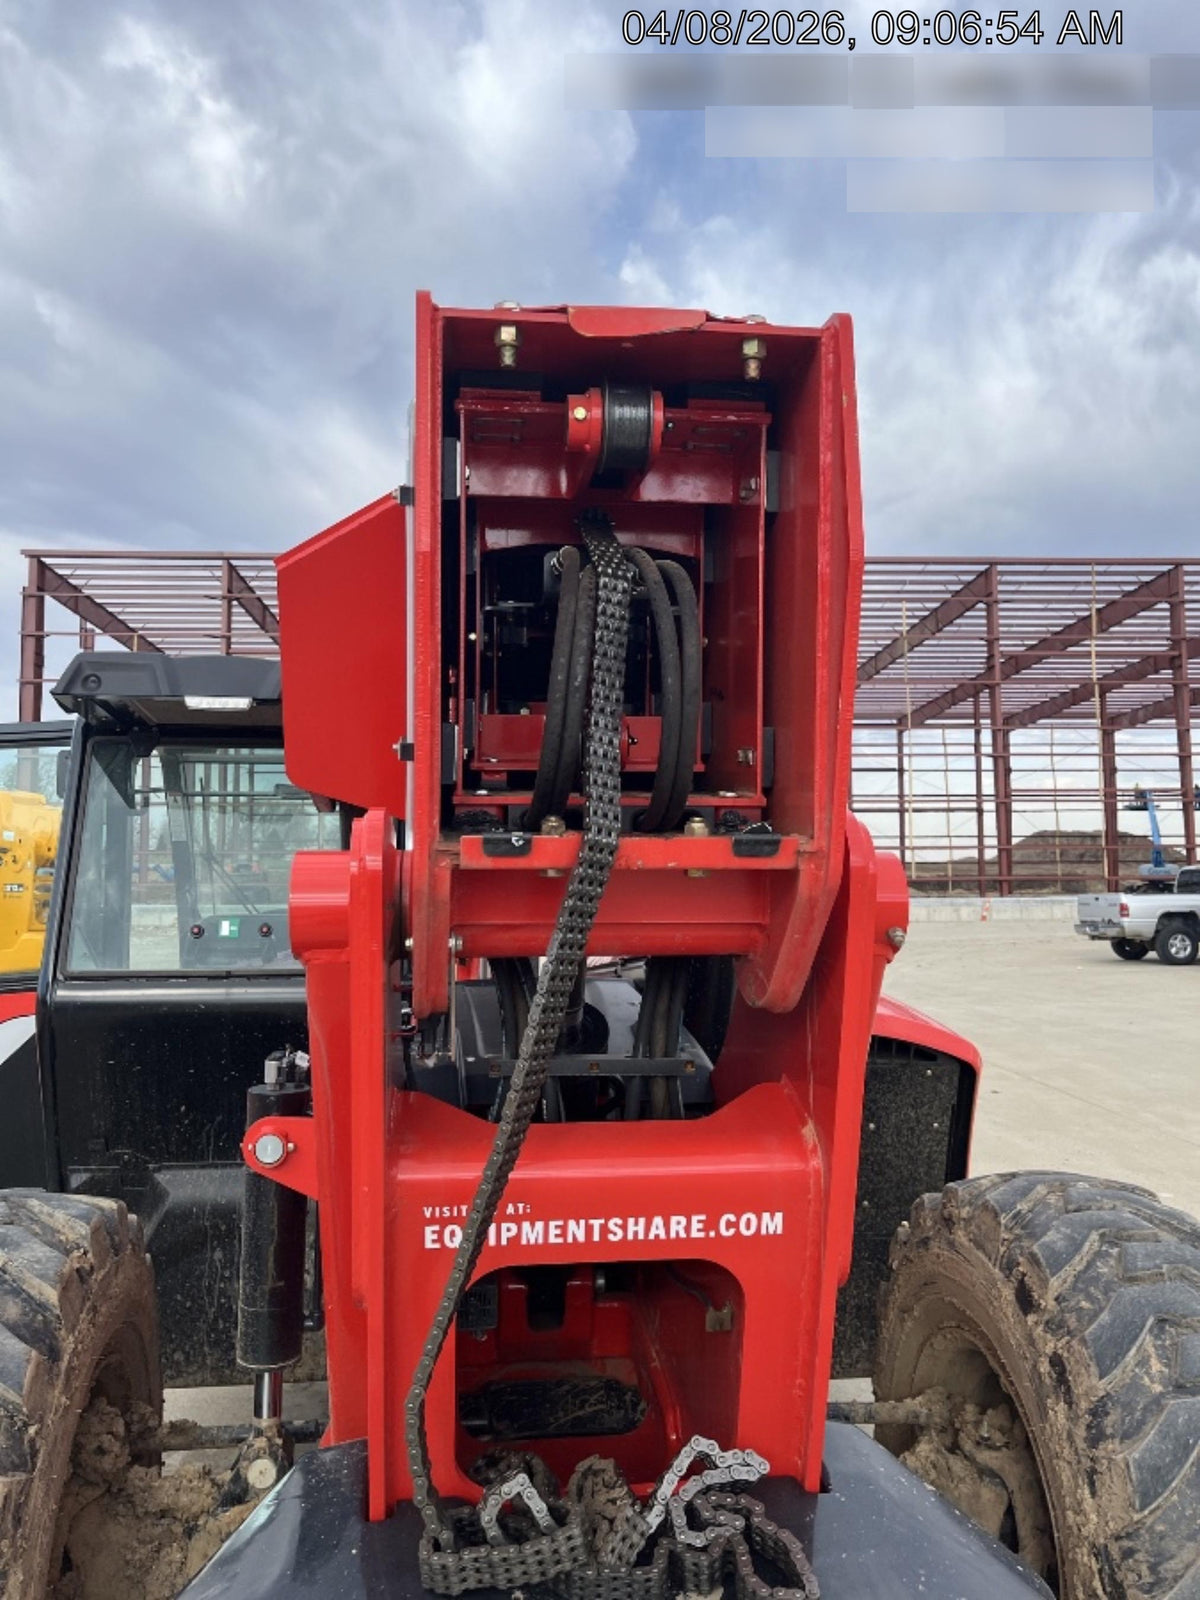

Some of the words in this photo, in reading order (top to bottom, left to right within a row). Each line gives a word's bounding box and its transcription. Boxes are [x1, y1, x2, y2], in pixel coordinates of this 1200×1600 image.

[423, 1205, 469, 1219] VISIT
[505, 1202, 531, 1215] AT:
[423, 1211, 784, 1249] EQIPMENTSHARE.COM
